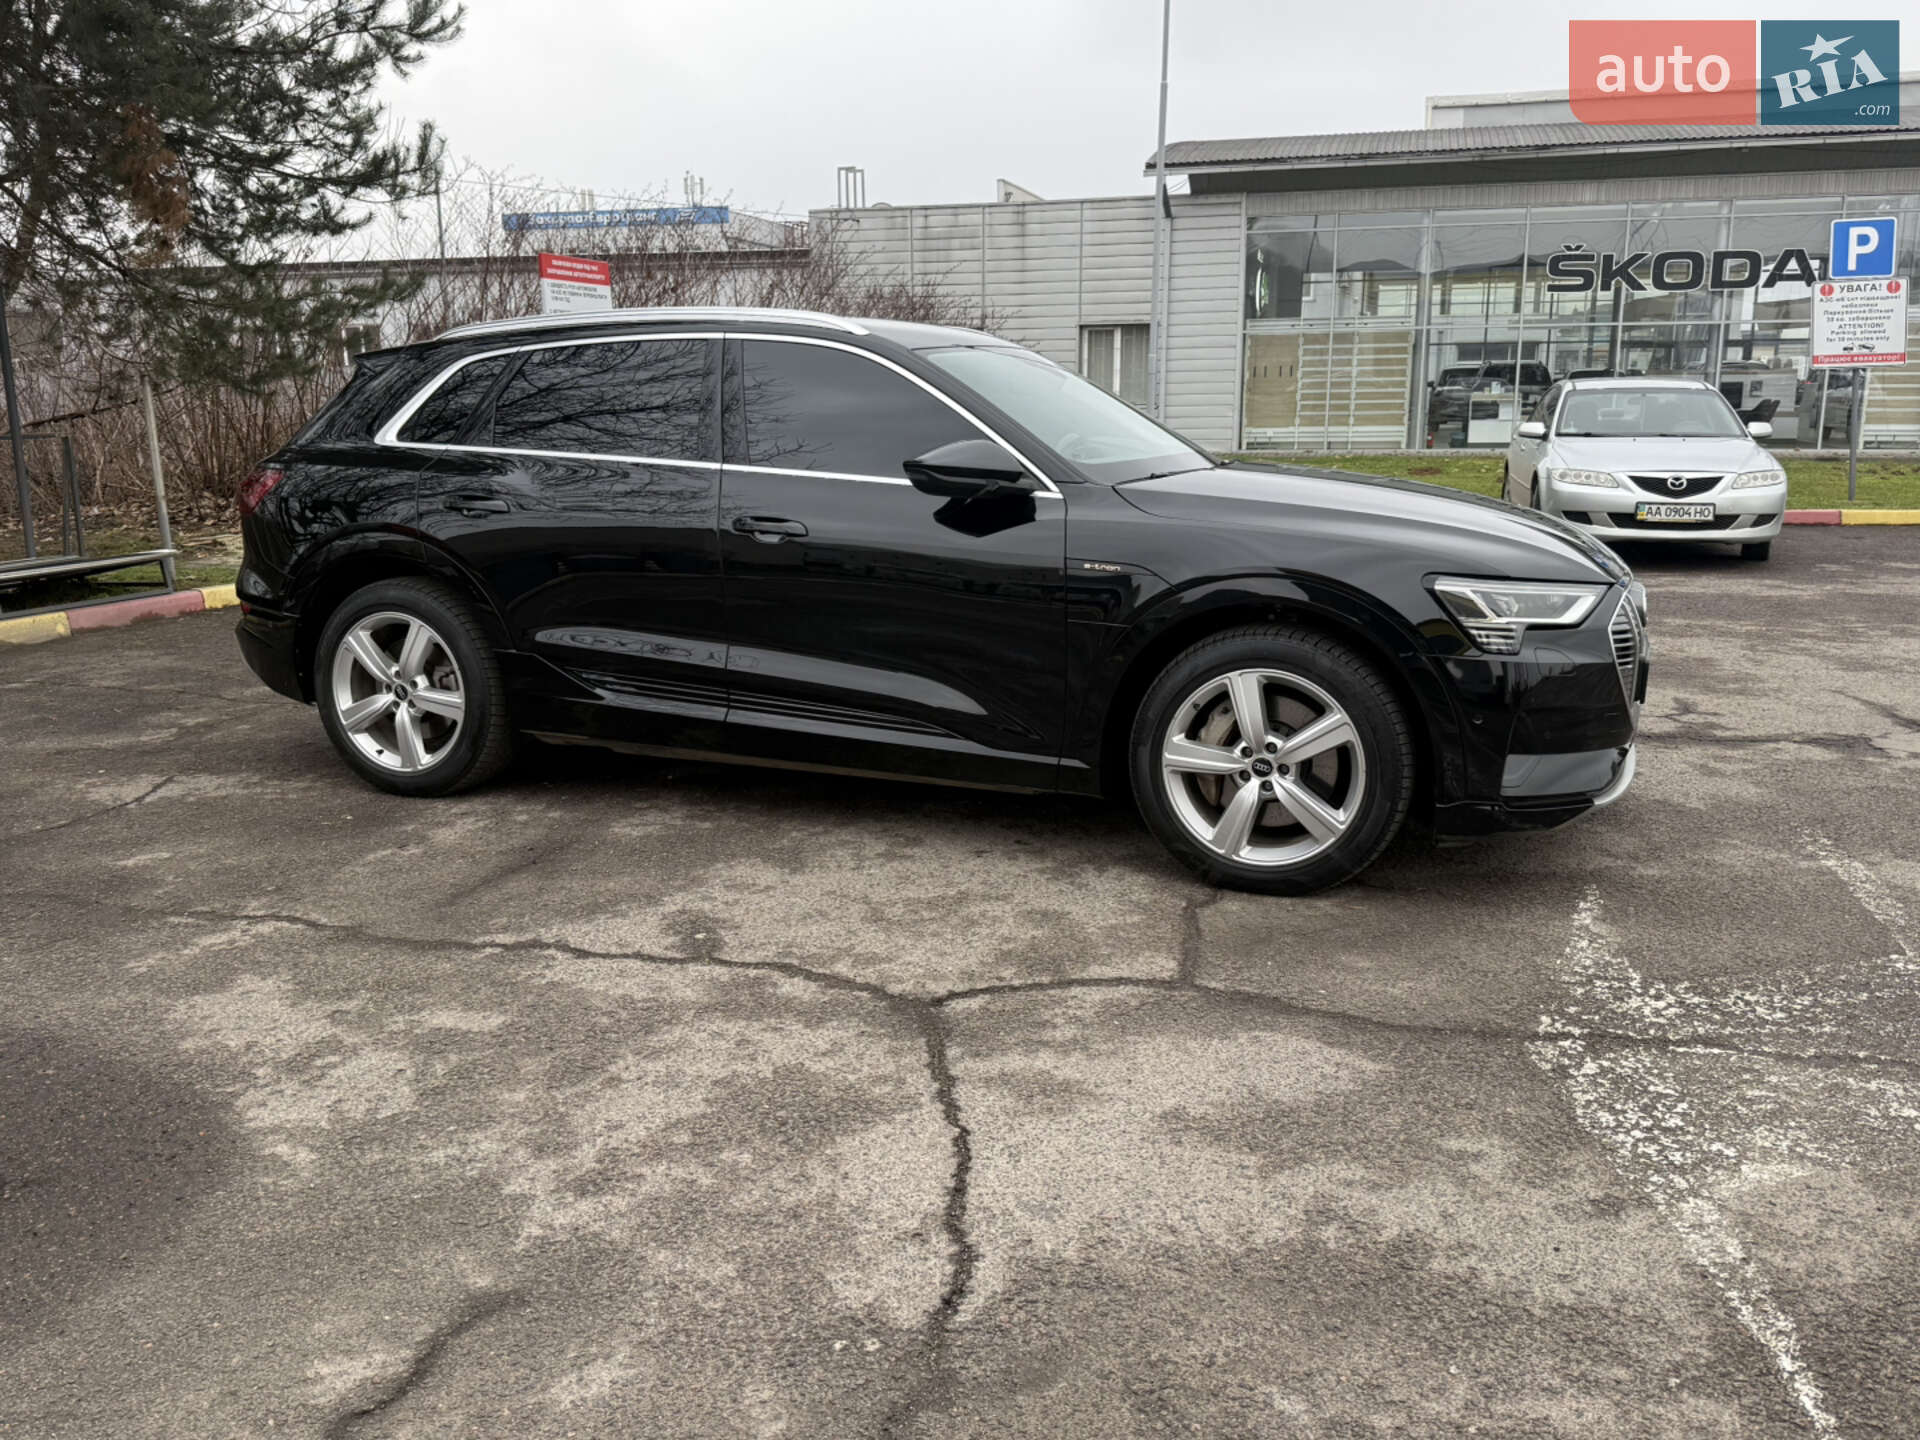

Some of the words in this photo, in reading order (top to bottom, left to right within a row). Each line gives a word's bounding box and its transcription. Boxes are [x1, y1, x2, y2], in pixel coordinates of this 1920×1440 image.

[1847, 226, 1879, 271] P
[1546, 244, 1819, 292] ŠKODA
[1839, 283, 1882, 293] УВАГА!
[1646, 506, 1662, 517] AA
[1664, 506, 1692, 518] 0904
